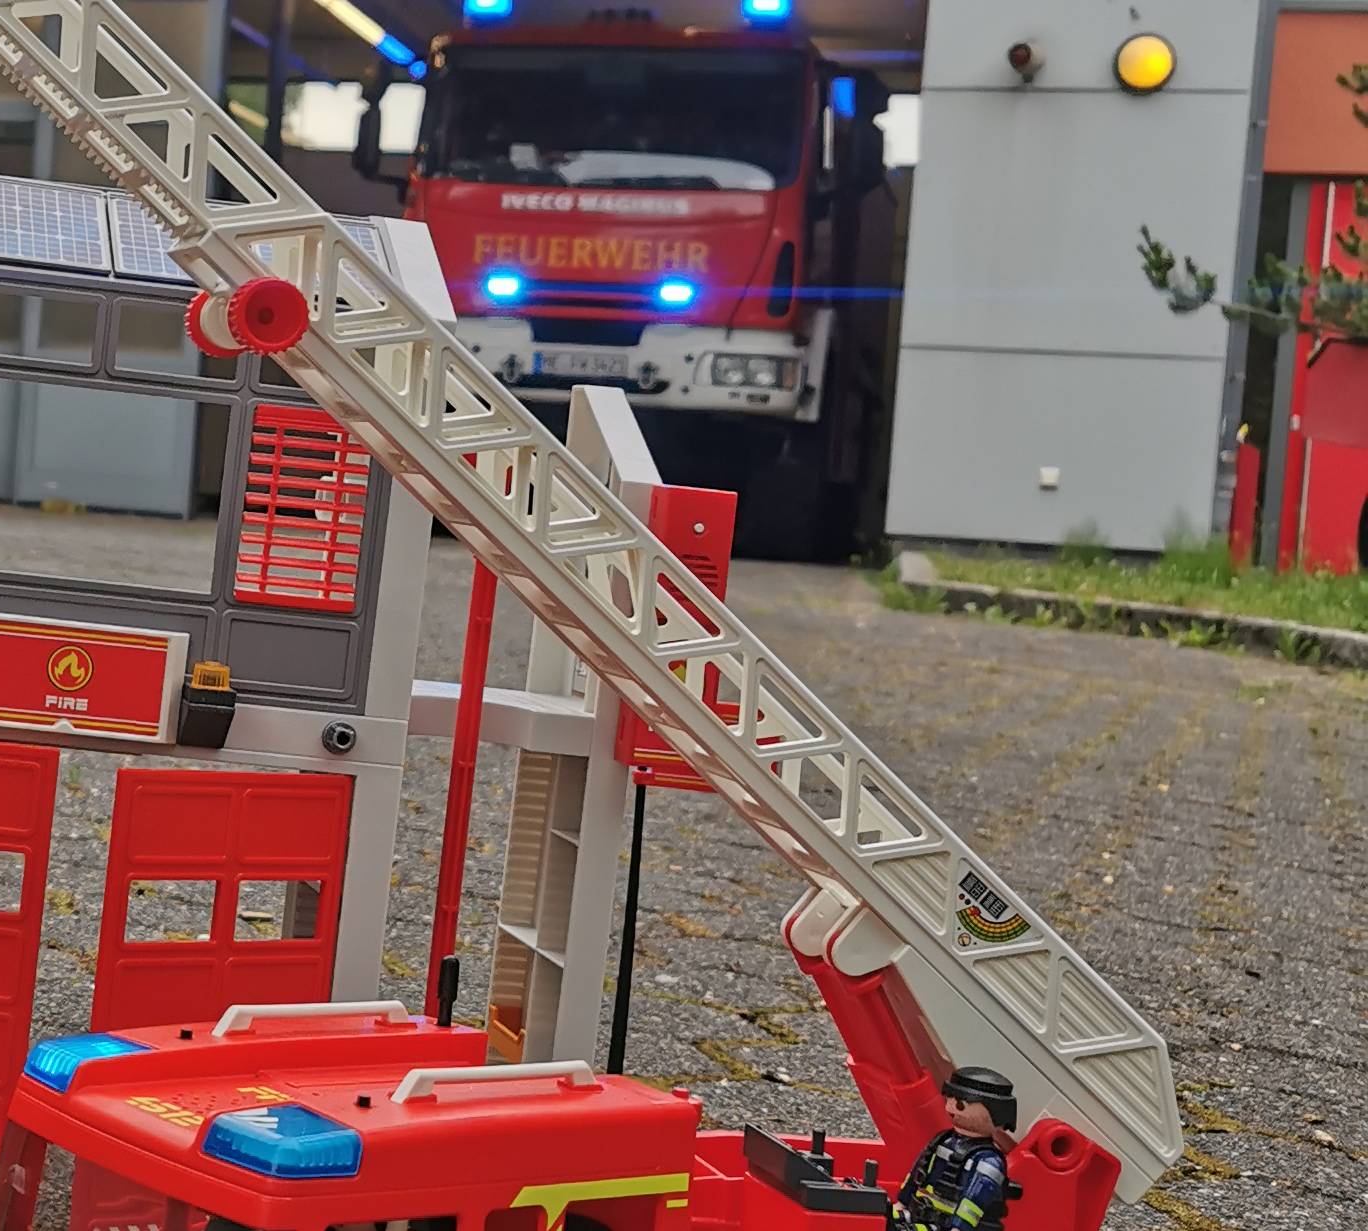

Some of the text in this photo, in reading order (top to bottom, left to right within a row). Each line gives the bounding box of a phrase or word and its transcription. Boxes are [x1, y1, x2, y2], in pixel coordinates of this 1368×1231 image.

[501, 192, 574, 211] IVECO
[474, 233, 710, 273] FEUERWEHR
[45, 694, 89, 711] FIRE
